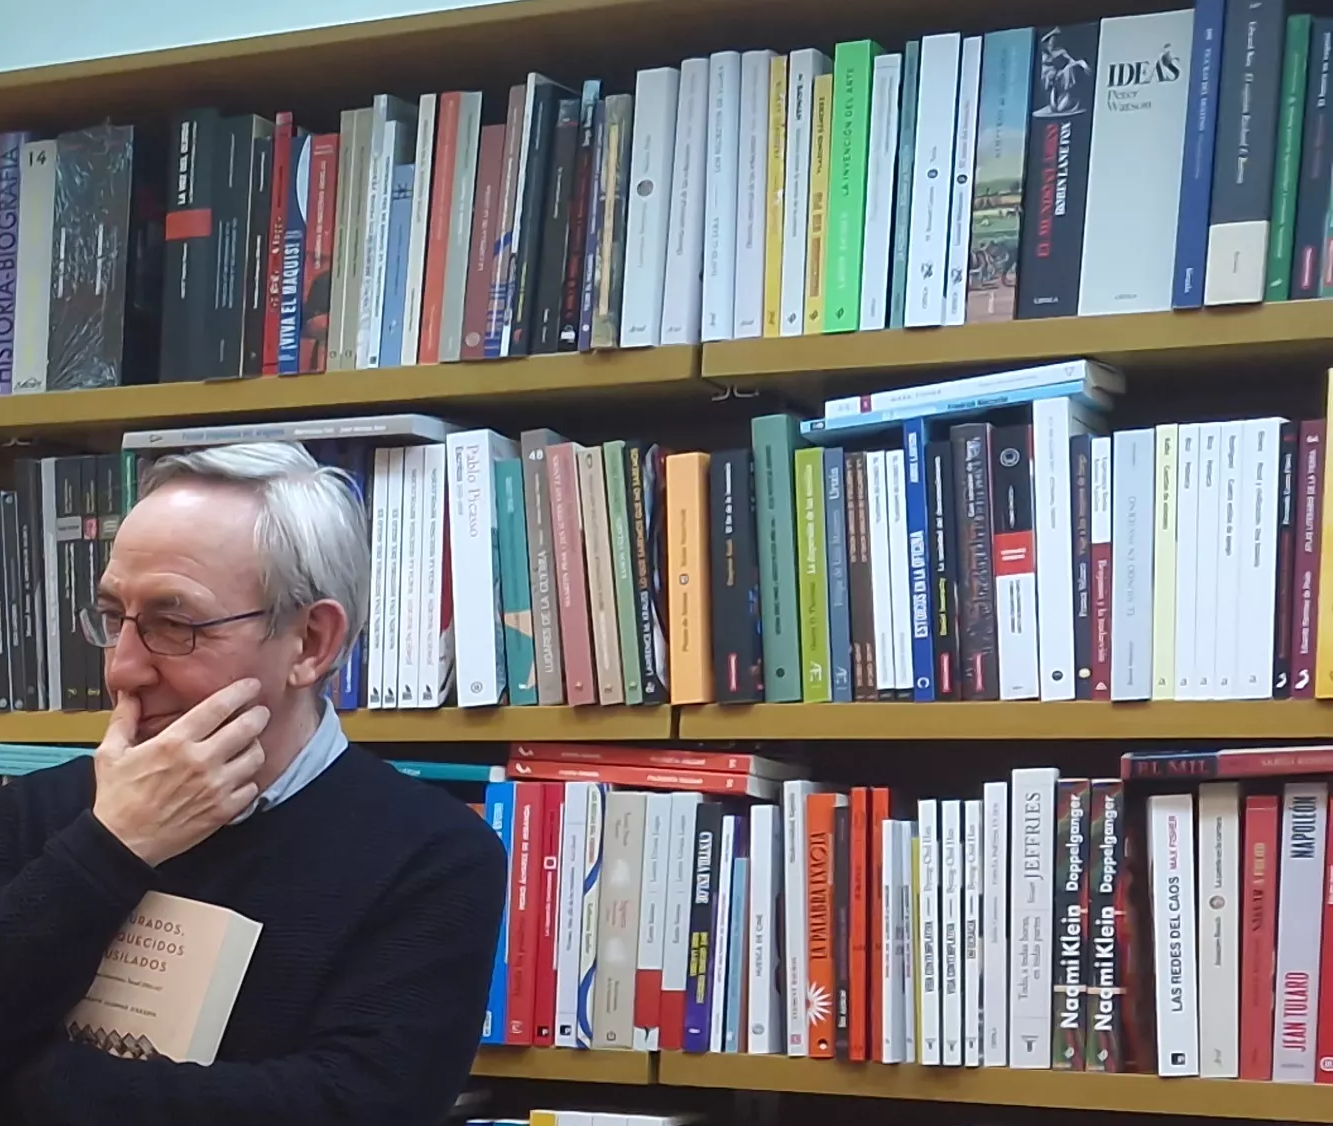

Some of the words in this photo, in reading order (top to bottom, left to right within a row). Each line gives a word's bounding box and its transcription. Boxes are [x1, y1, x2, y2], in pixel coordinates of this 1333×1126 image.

[1106, 54, 1181, 88] IDEAS
[29, 151, 47, 167] 14
[465, 444, 483, 484] Pablo
[466, 488, 481, 538] Picasso
[1023, 791, 1043, 880] JEFFRIES
[1065, 794, 1083, 891] Doppelganger
[1099, 795, 1117, 892] Doppelganger
[1168, 815, 1178, 848] FISHER
[1288, 796, 1316, 860] NAPOLEÓN
[809, 831, 828, 884] EXACTA
[1168, 849, 1178, 871] MAX
[1168, 876, 1181, 912] CAOS
[129, 915, 185, 937] URADOS,
[754, 913, 764, 931] CINE
[809, 887, 828, 941] PALABRA
[1059, 904, 1080, 956] Klein
[1093, 906, 1114, 958] Klein
[1169, 914, 1181, 939] DEL
[117, 932, 185, 956] QUECIDOS
[754, 934, 764, 944] DE
[809, 946, 828, 959] LA
[104, 950, 168, 973] USILADOS
[754, 946, 764, 977] HUESCA
[1169, 941, 1183, 985] REDES
[1060, 959, 1080, 1029] Naomi
[1094, 961, 1114, 1031] Naomi
[1170, 987, 1183, 1012] LAS
[1284, 971, 1309, 1017] TULARD
[1282, 1021, 1306, 1052] JEAN
